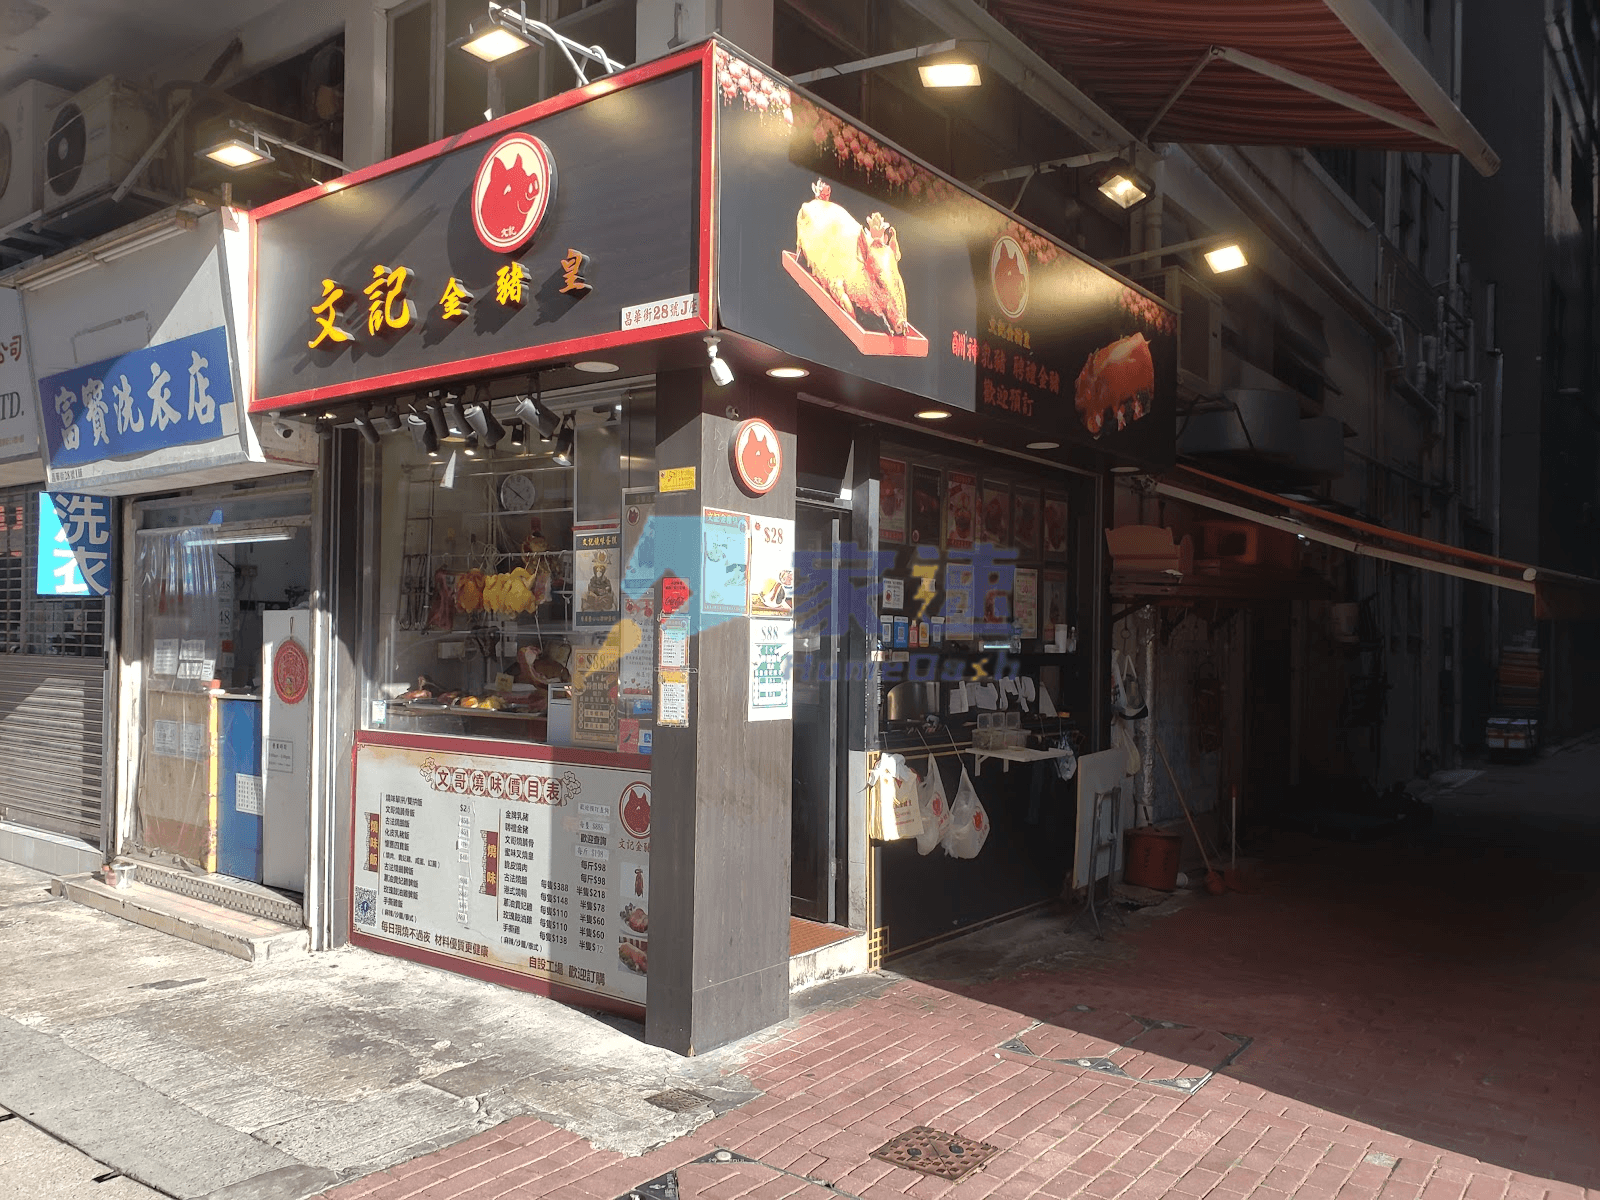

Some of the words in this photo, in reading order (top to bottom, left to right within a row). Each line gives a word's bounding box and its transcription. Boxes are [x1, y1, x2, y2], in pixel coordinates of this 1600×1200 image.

[308, 249, 591, 348] 文記金豬皇
[624, 298, 698, 327] 昌華街28號J座
[764, 526, 784, 545] $28
[53, 494, 110, 596] 洗衣
[437, 769, 560, 802] 文哥燒味價目表
[581, 834, 607, 847] 歡迎查詢
[576, 886, 606, 899] 半隻$218
[540, 905, 568, 918] 每隻$110
[580, 900, 606, 913] 半隻$78
[540, 918, 568, 932] 每隻$110
[579, 913, 605, 926] 半隻$60
[380, 920, 431, 946] 每日現燒不過夜
[435, 933, 490, 960] 材料優質更健康
[579, 926, 605, 940] 半隻$60
[529, 956, 563, 977] 自設工場
[569, 965, 606, 987] 歡迎訂購
